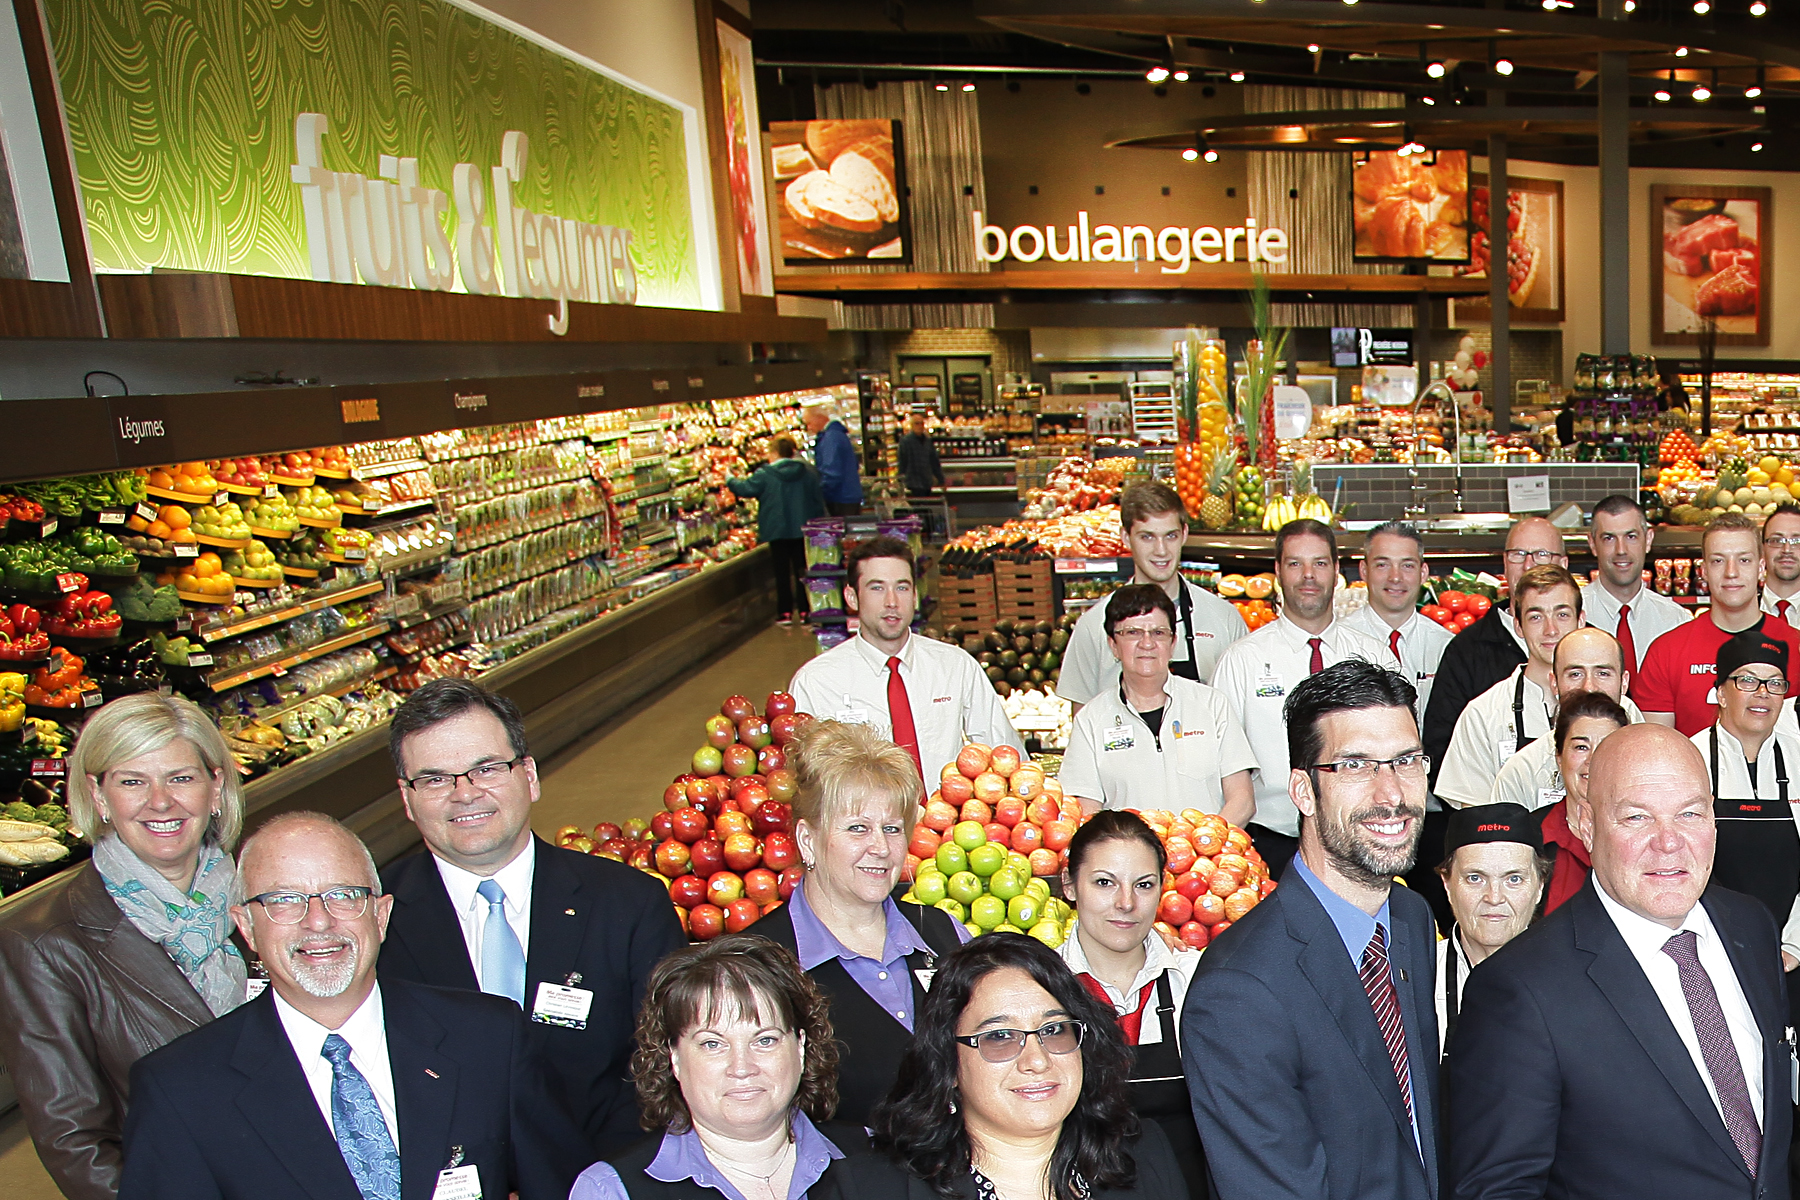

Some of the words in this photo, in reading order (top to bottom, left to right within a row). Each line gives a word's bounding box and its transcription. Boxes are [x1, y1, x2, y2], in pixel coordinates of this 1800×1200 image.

[290, 112, 453, 291] fruits
[453, 162, 501, 295] &
[973, 210, 1288, 274] boulangerie
[119, 416, 165, 443] Légumes
[1761, 642, 1782, 654] metro
[1739, 803, 1762, 811] metro
[1477, 823, 1511, 832] metro
